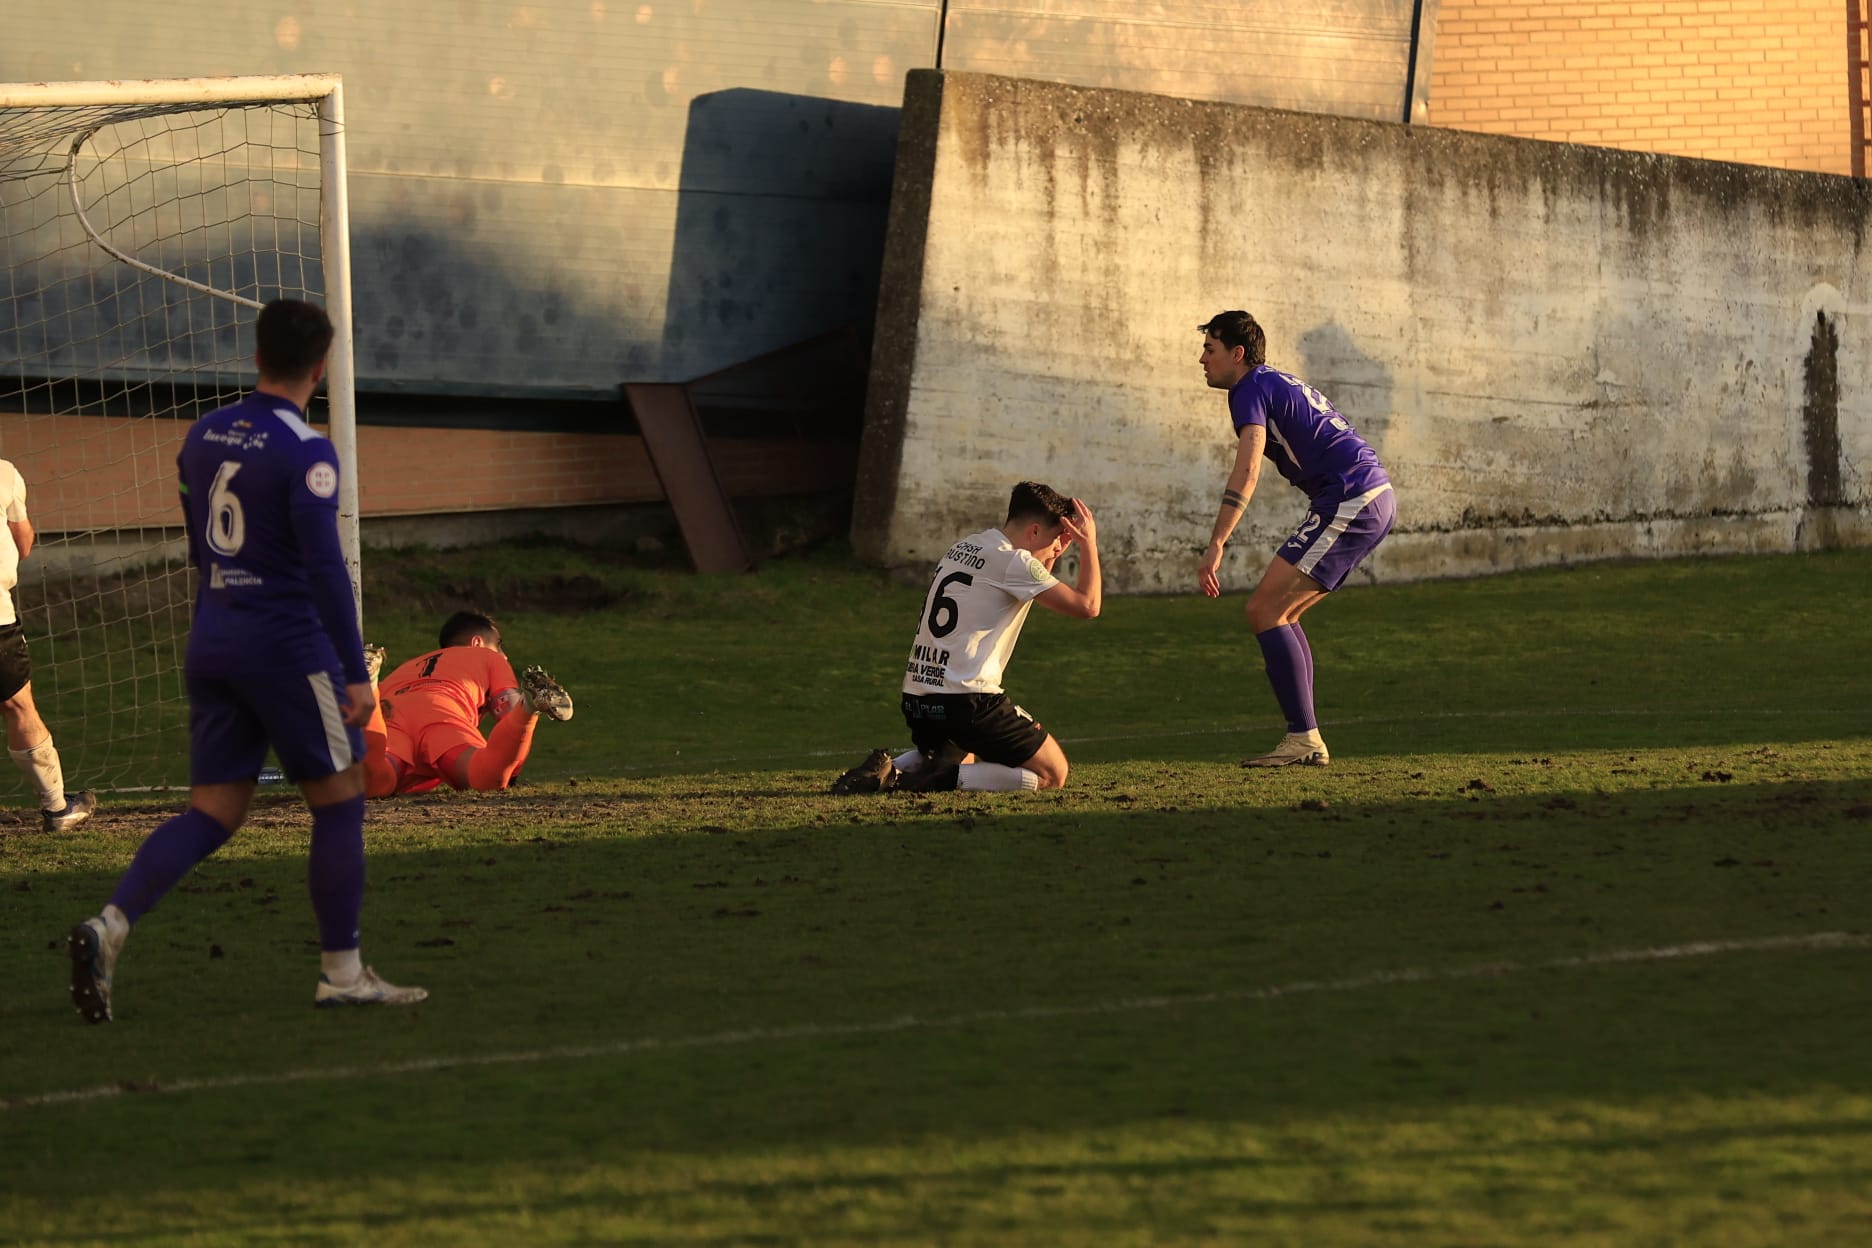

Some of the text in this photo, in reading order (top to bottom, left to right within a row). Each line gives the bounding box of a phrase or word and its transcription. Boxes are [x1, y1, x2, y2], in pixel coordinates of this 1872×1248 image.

[205, 461, 245, 557] 6
[956, 541, 983, 555] CASA
[946, 548, 986, 570] USTINO
[920, 664, 946, 679] VERDE
[924, 677, 944, 687] RURAL
